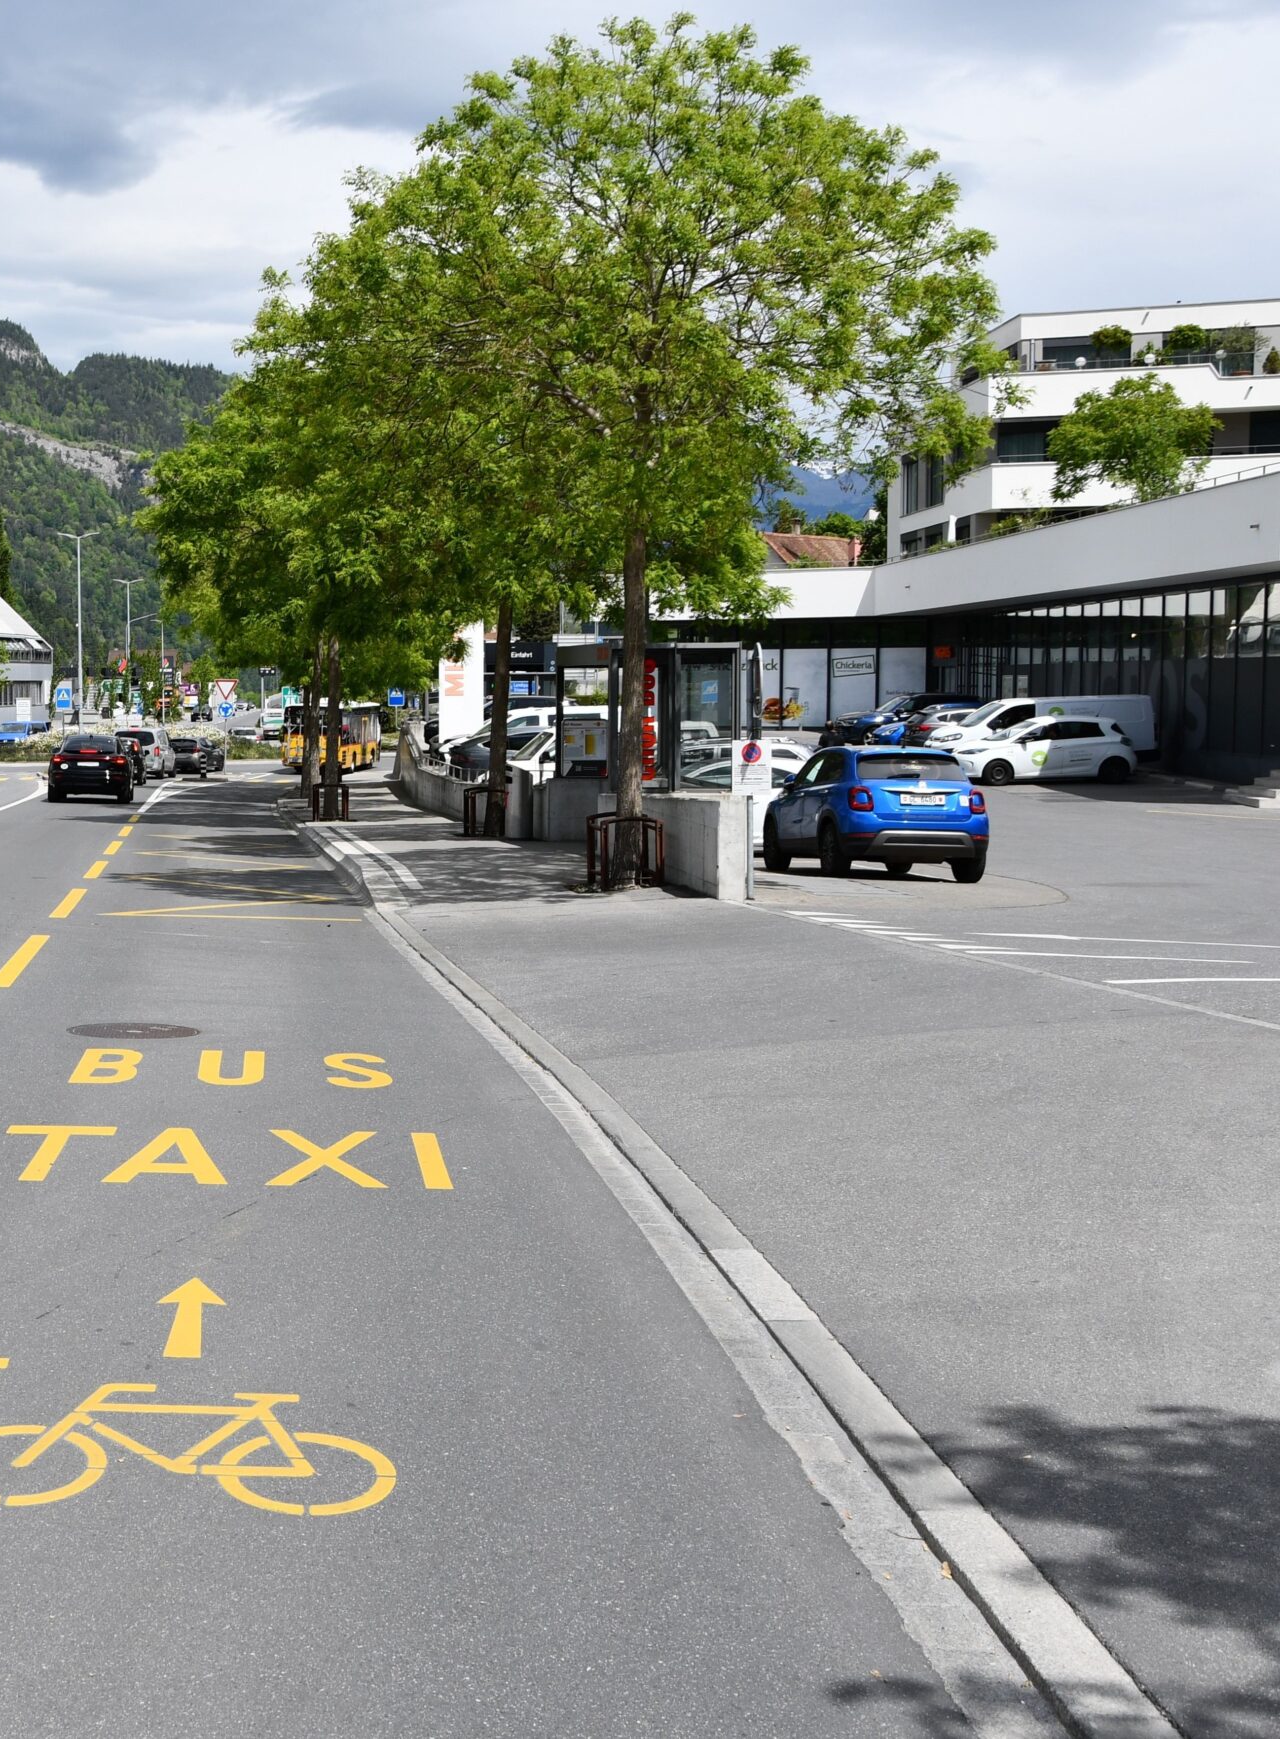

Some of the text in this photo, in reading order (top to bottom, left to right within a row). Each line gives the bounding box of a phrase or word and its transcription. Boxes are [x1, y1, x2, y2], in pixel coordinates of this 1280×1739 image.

[835, 660, 872, 670] Chickeria
[68, 1048, 393, 1089] BUS
[6, 1125, 454, 1190] TAXI
